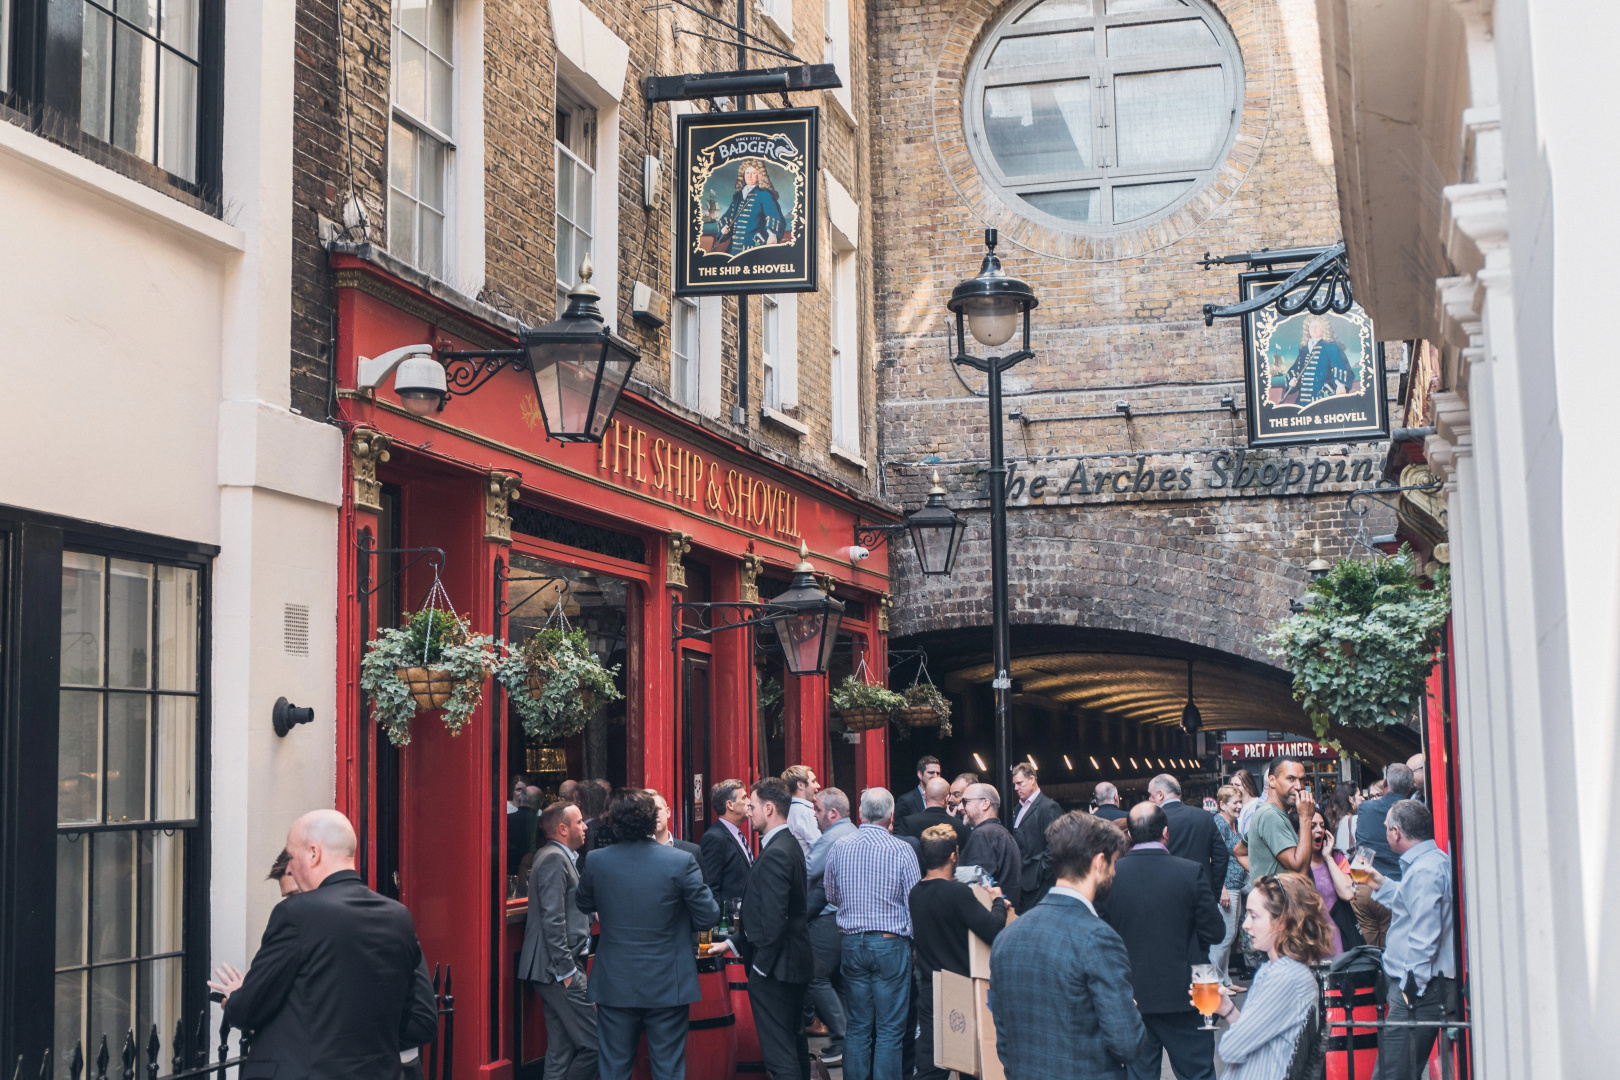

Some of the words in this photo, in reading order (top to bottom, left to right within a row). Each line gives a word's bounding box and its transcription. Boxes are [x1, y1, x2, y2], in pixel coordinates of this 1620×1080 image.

[718, 141, 777, 159] BADGER
[698, 267, 718, 276] THE
[719, 265, 742, 275] SHIP
[743, 265, 751, 274] &
[752, 264, 796, 274] SHOVELL
[1269, 418, 1289, 428] THE
[1290, 416, 1313, 426] SHIP
[1314, 415, 1322, 424] &
[1323, 412, 1367, 424] SHOVELL
[597, 412, 647, 484] THE
[654, 437, 703, 503] SHIP
[707, 462, 724, 512] &
[727, 469, 801, 539] SHOVELL
[1060, 456, 1193, 496] Arches
[1244, 743, 1266, 758] PRET
[1268, 743, 1275, 758] A
[1277, 742, 1314, 757] MANGER
